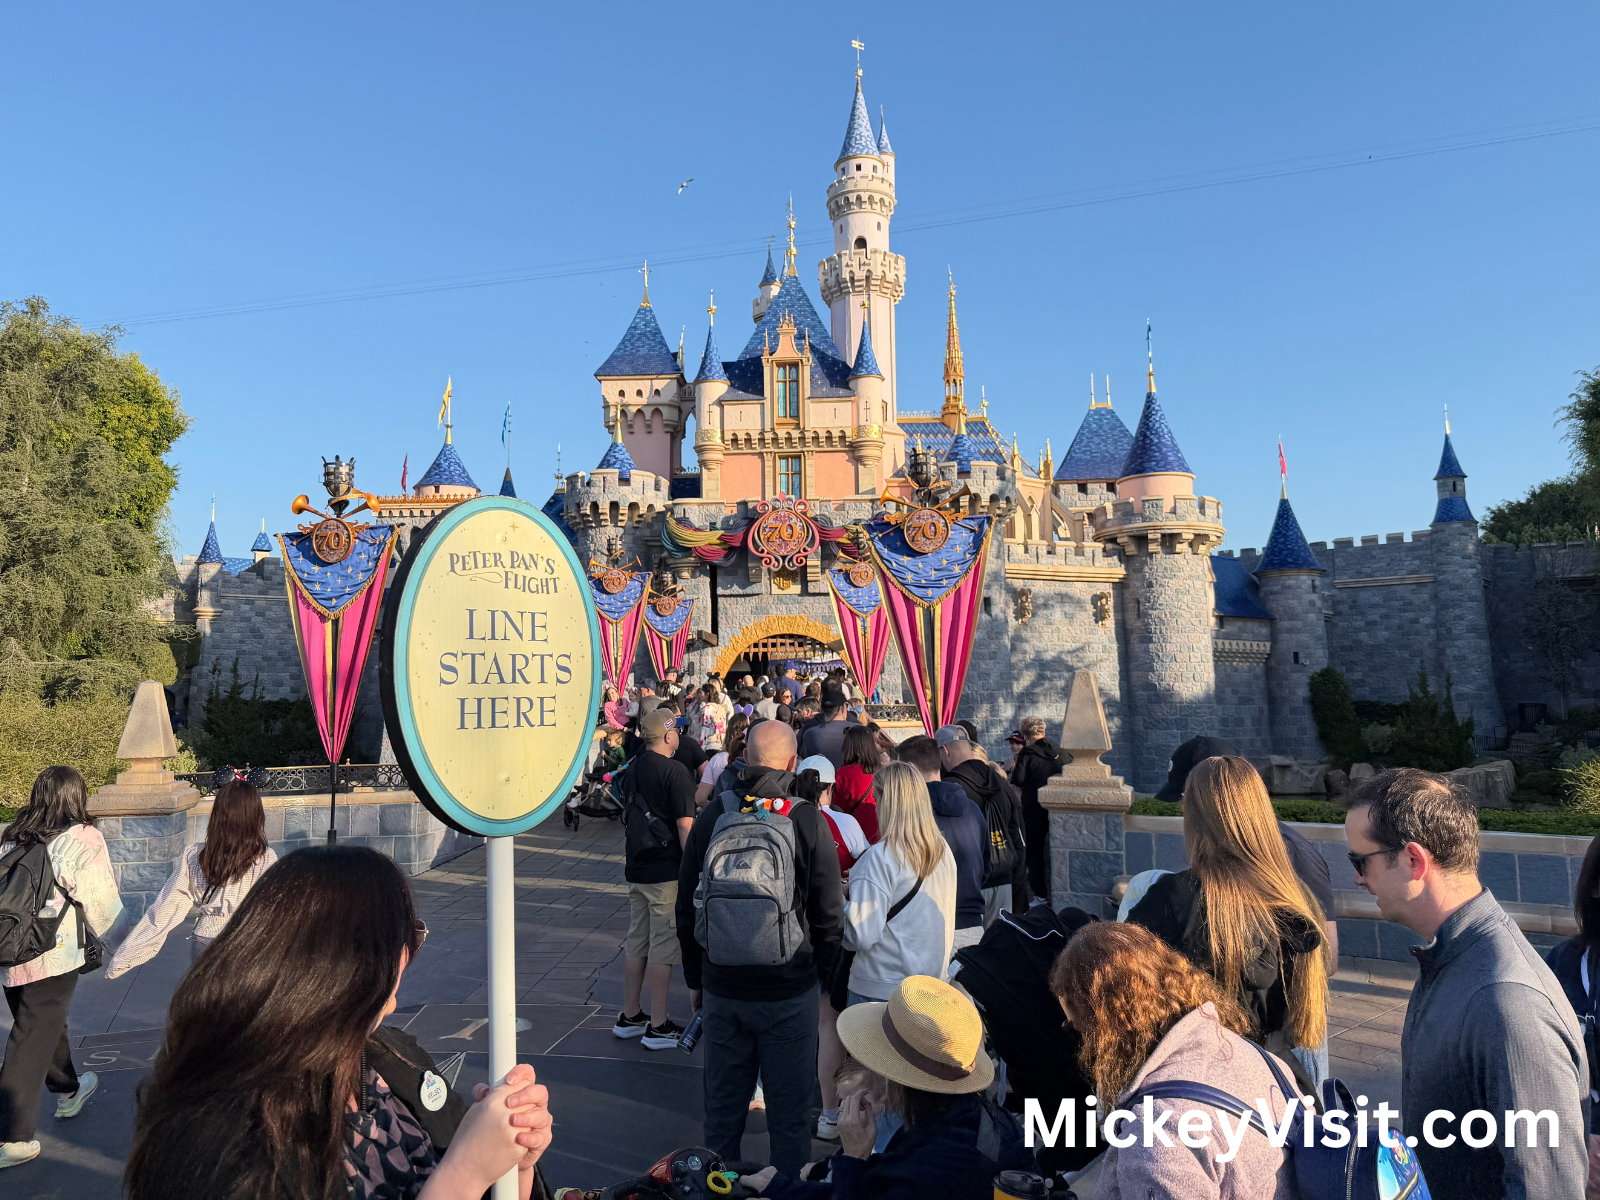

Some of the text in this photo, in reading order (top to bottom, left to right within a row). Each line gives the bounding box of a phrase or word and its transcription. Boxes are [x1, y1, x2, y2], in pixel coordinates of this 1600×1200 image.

[317, 532, 346, 550] 70
[767, 522, 799, 542] 70
[911, 520, 942, 541] 70
[447, 549, 556, 575] PETER PAN'S
[503, 569, 561, 595] FLIGHT
[605, 576, 624, 587] 70
[854, 569, 871, 580] 70
[660, 601, 672, 611] 70
[465, 608, 549, 644] LINE
[438, 650, 572, 687] STARTS
[456, 694, 557, 730] HERE
